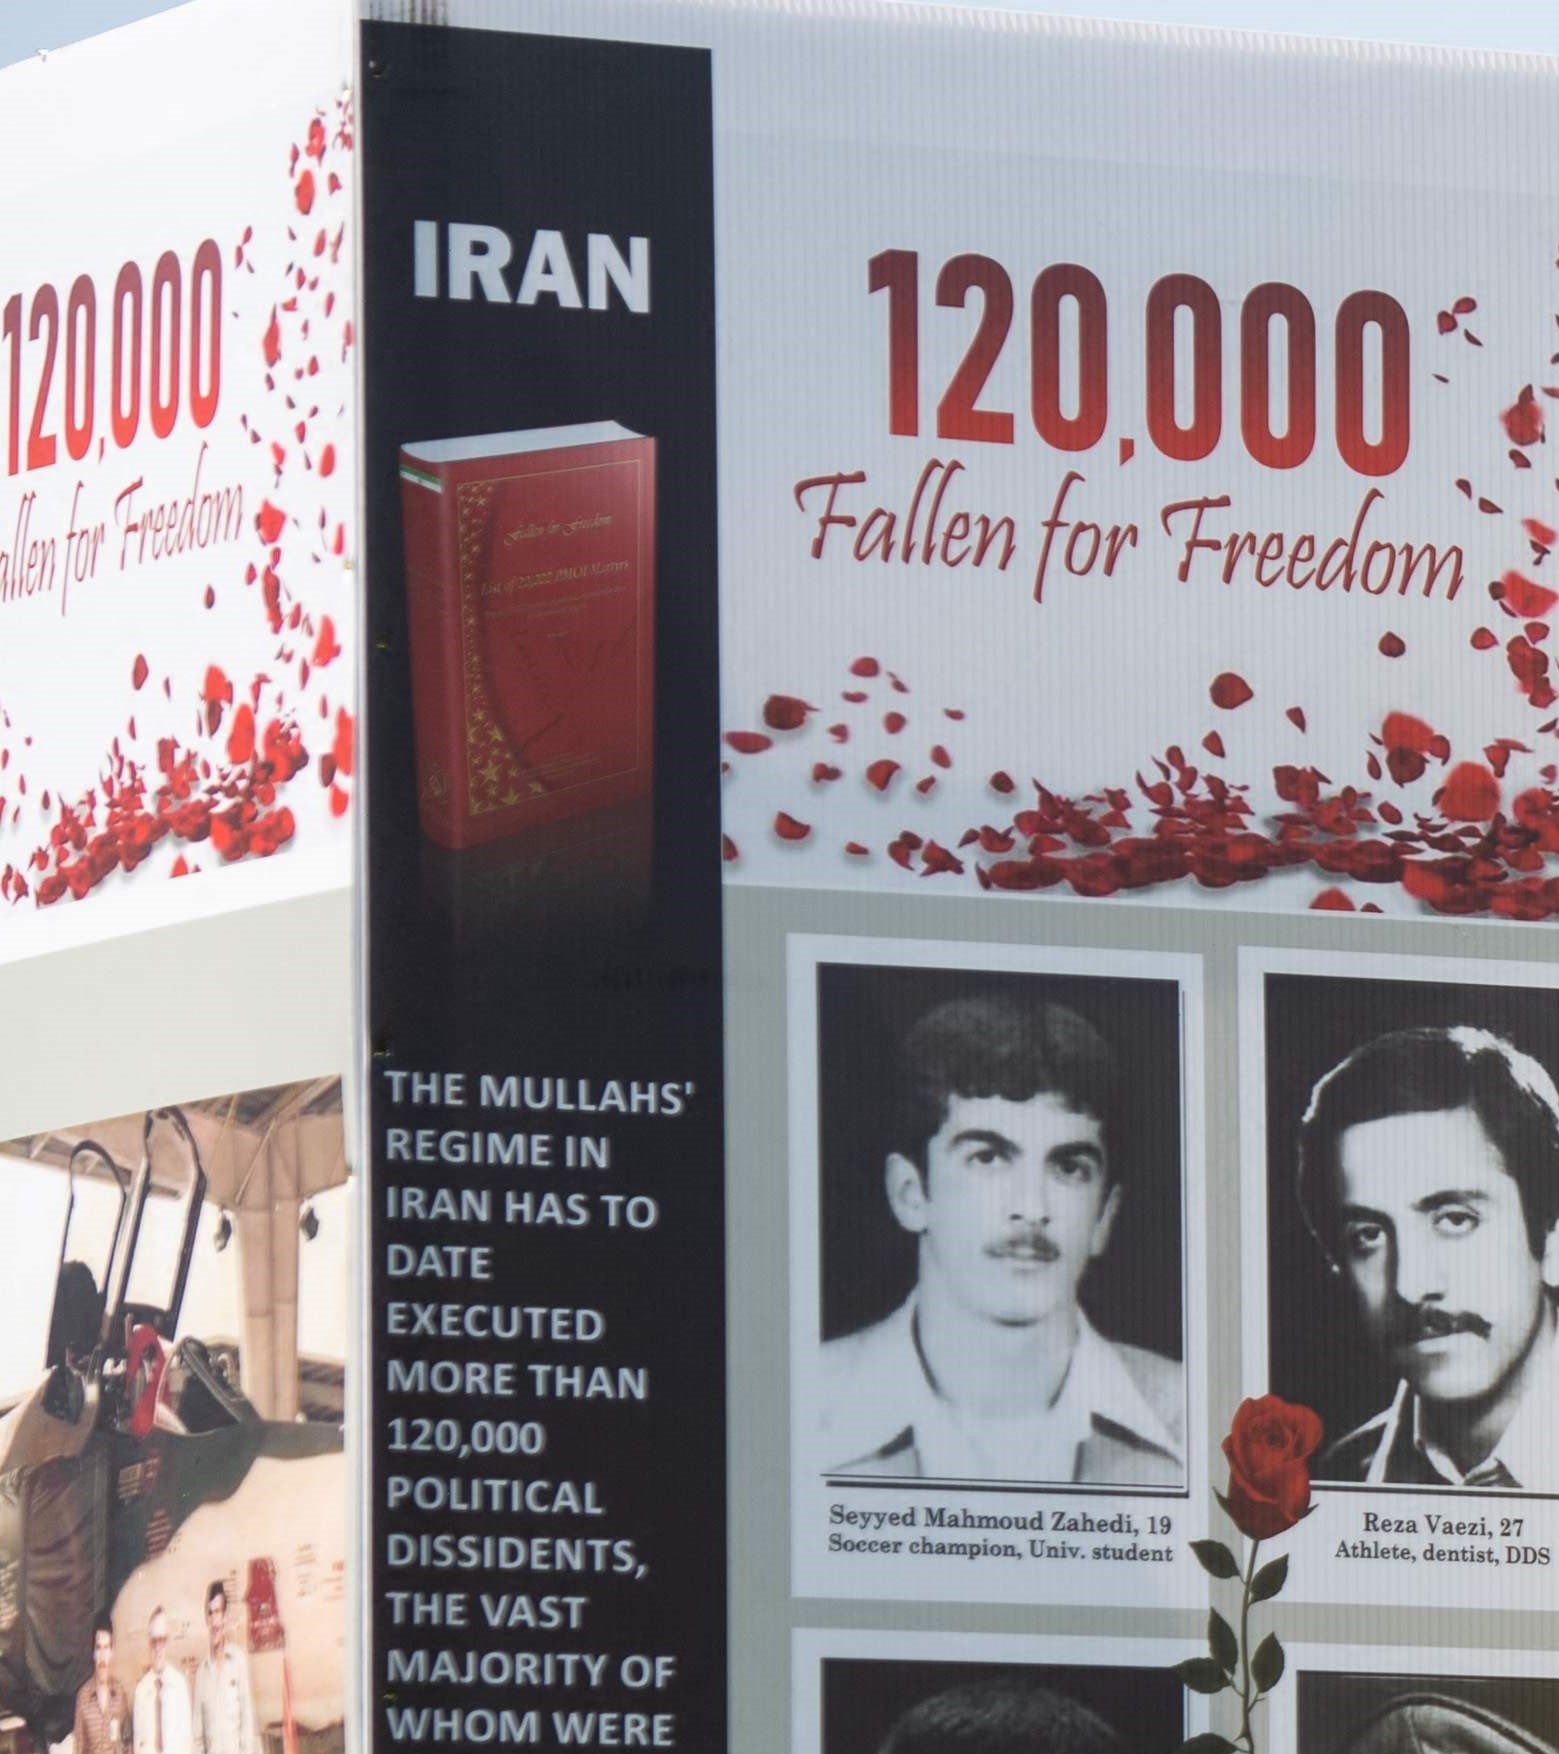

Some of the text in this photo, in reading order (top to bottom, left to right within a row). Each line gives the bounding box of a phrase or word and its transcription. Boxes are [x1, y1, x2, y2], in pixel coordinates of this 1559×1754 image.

[415, 221, 649, 313] IRAN
[1, 239, 222, 476] 120,000
[867, 247, 1411, 477] 120,000
[0, 440, 242, 616] allen for Freedom
[793, 458, 1466, 604] Fallen for Freedom
[384, 1071, 692, 1115] THE MULLAHS'
[388, 1129, 608, 1168] REGIME IN
[388, 1187, 657, 1228] IRAN HAS TO
[388, 1244, 490, 1279] DATE
[388, 1303, 603, 1340] EXECUTED
[388, 1360, 646, 1399] MORE THAN
[389, 1418, 544, 1458] 120,000
[388, 1477, 603, 1514] POLITICAL
[830, 1504, 1171, 1537] Seyyed Mahmoud Zahedi, 19
[1364, 1512, 1523, 1539] Reza Vaezi, 27
[388, 1534, 646, 1579] DISSIDENTS,
[829, 1533, 1173, 1562] Soccer champion, Univ. student
[1335, 1541, 1550, 1566] Athlete, dentist, DDS
[386, 1592, 587, 1628] THE VAST
[388, 1650, 674, 1688] MAJORITY OF
[387, 1708, 672, 1746] WHOM WERE
